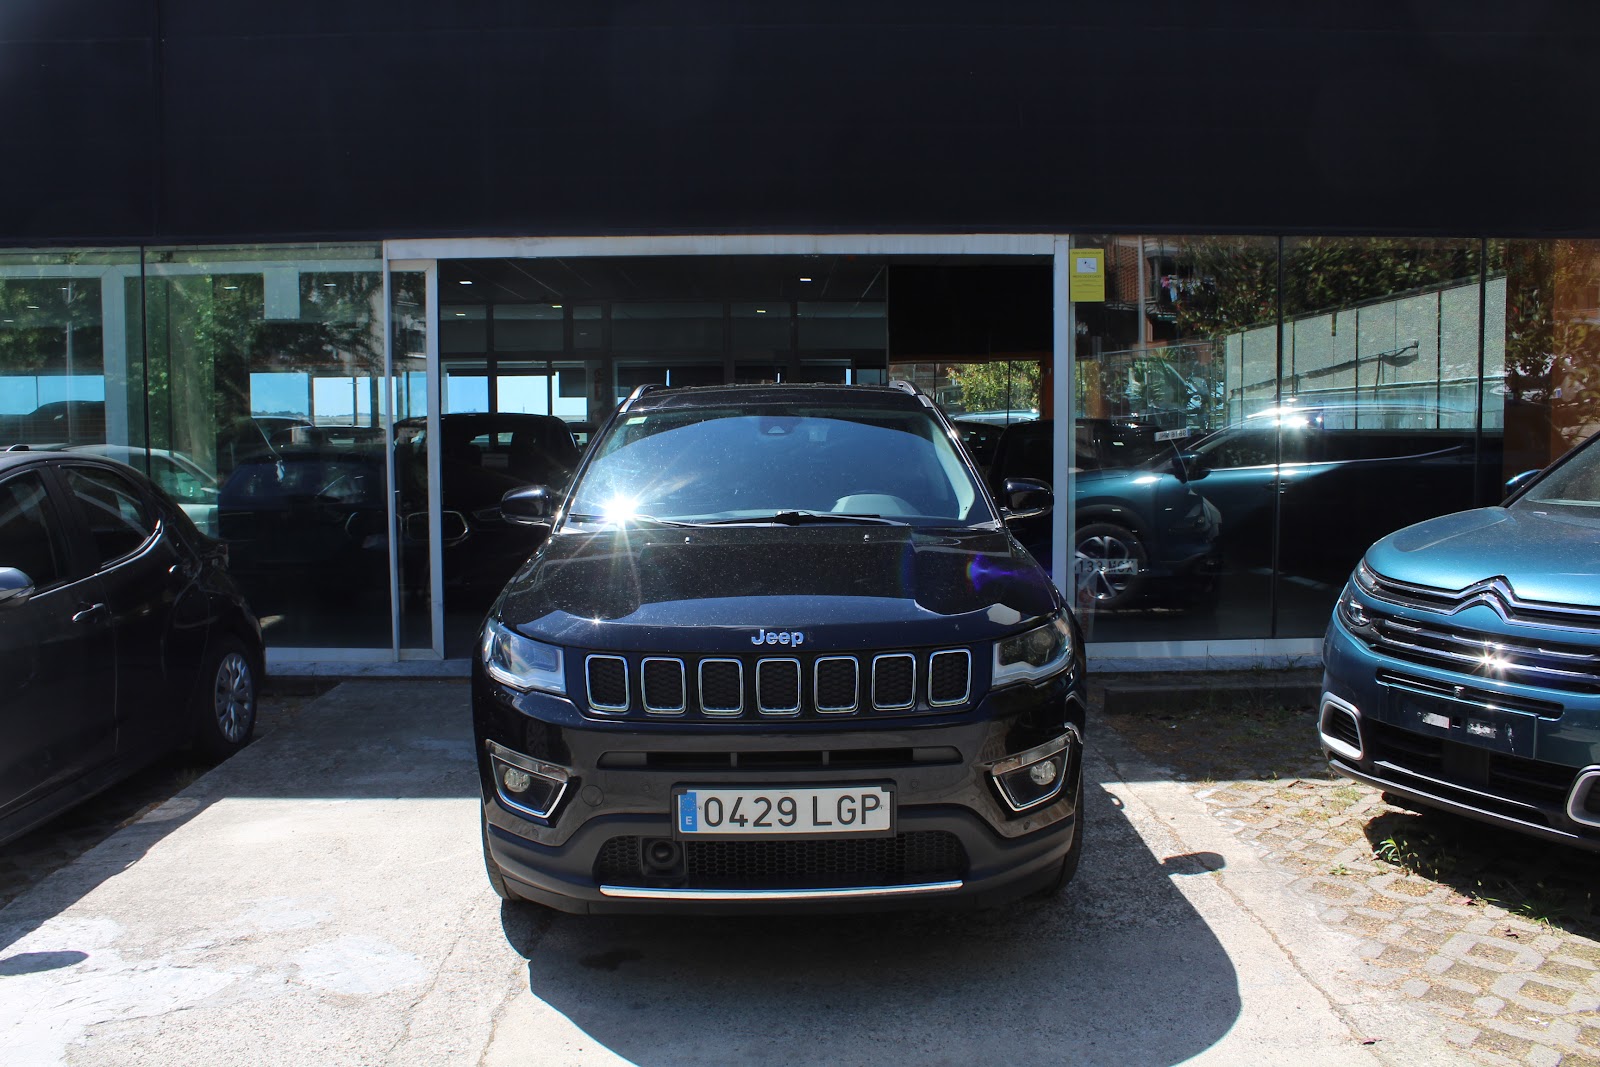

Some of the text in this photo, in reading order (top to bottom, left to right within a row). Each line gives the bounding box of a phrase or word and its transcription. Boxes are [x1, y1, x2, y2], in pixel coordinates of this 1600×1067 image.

[1075, 560, 1104, 573] 133
[751, 629, 804, 647] Jeep
[685, 794, 881, 827] E 0429 LGP
